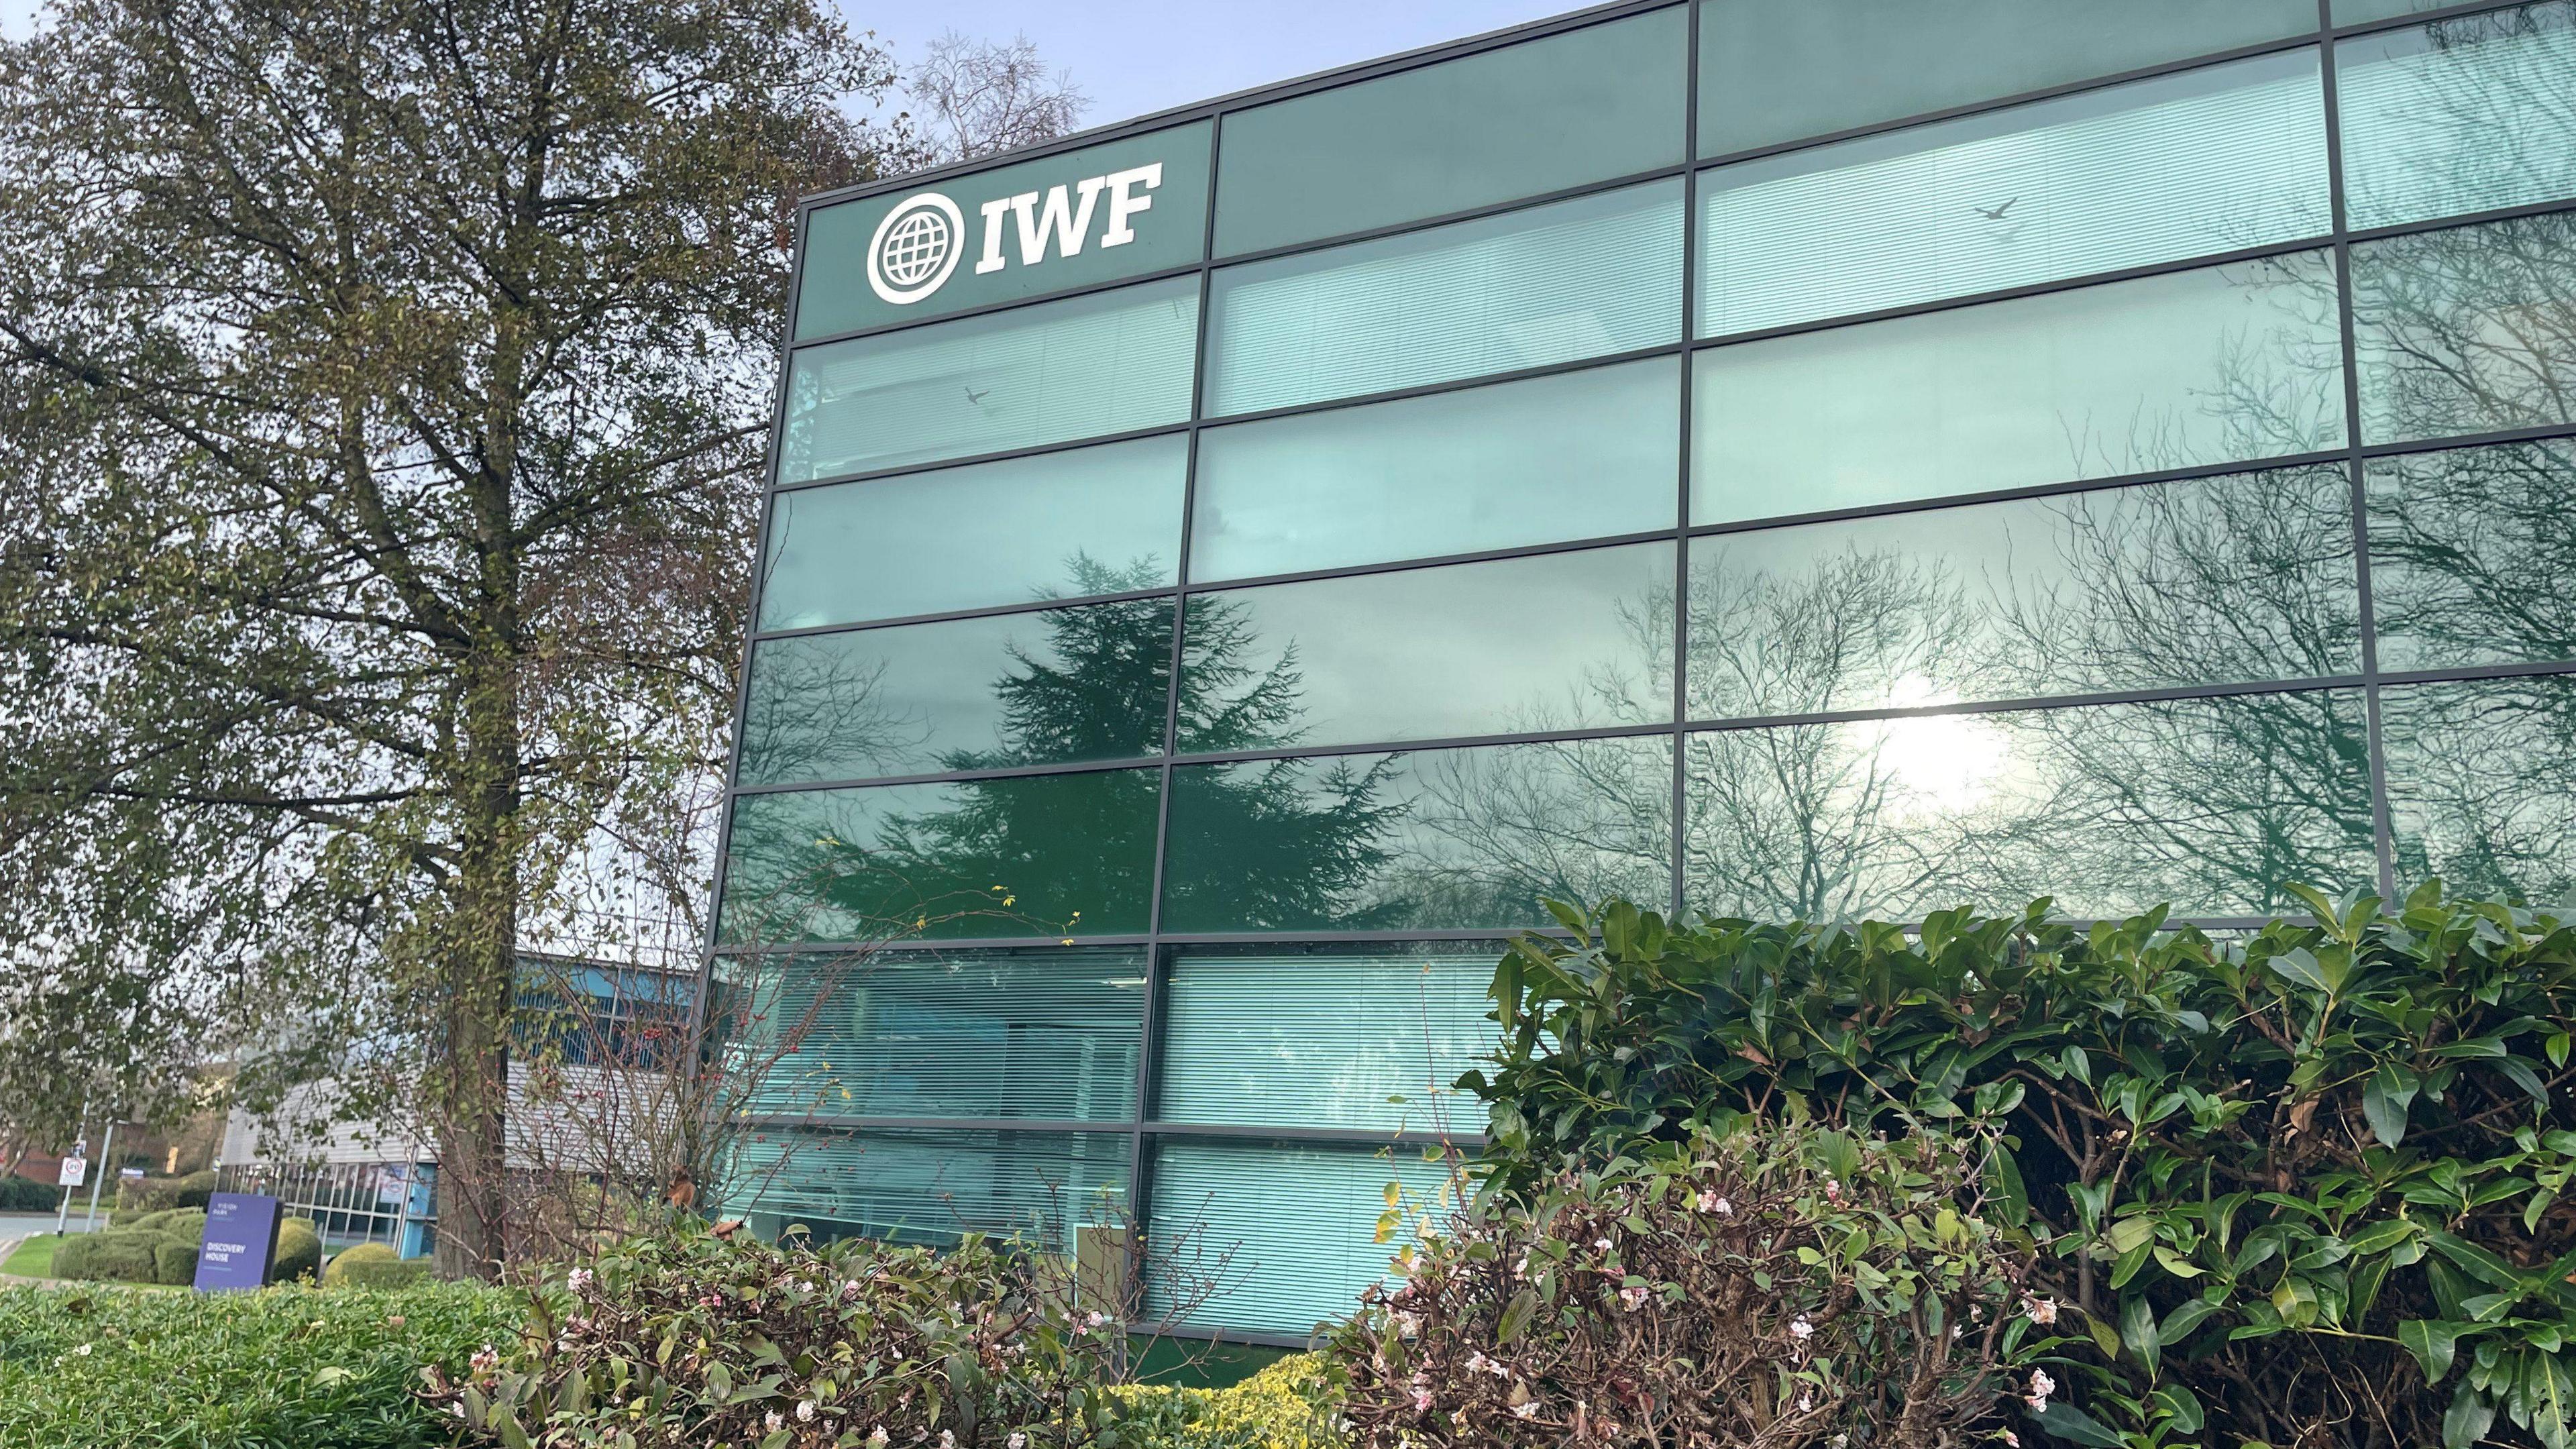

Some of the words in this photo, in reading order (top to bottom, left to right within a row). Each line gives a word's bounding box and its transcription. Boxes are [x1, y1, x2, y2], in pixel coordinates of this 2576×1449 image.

[975, 162, 1163, 274] IWF
[207, 1242, 246, 1254] DISCOVERY
[205, 1252, 229, 1263] HOUSE
